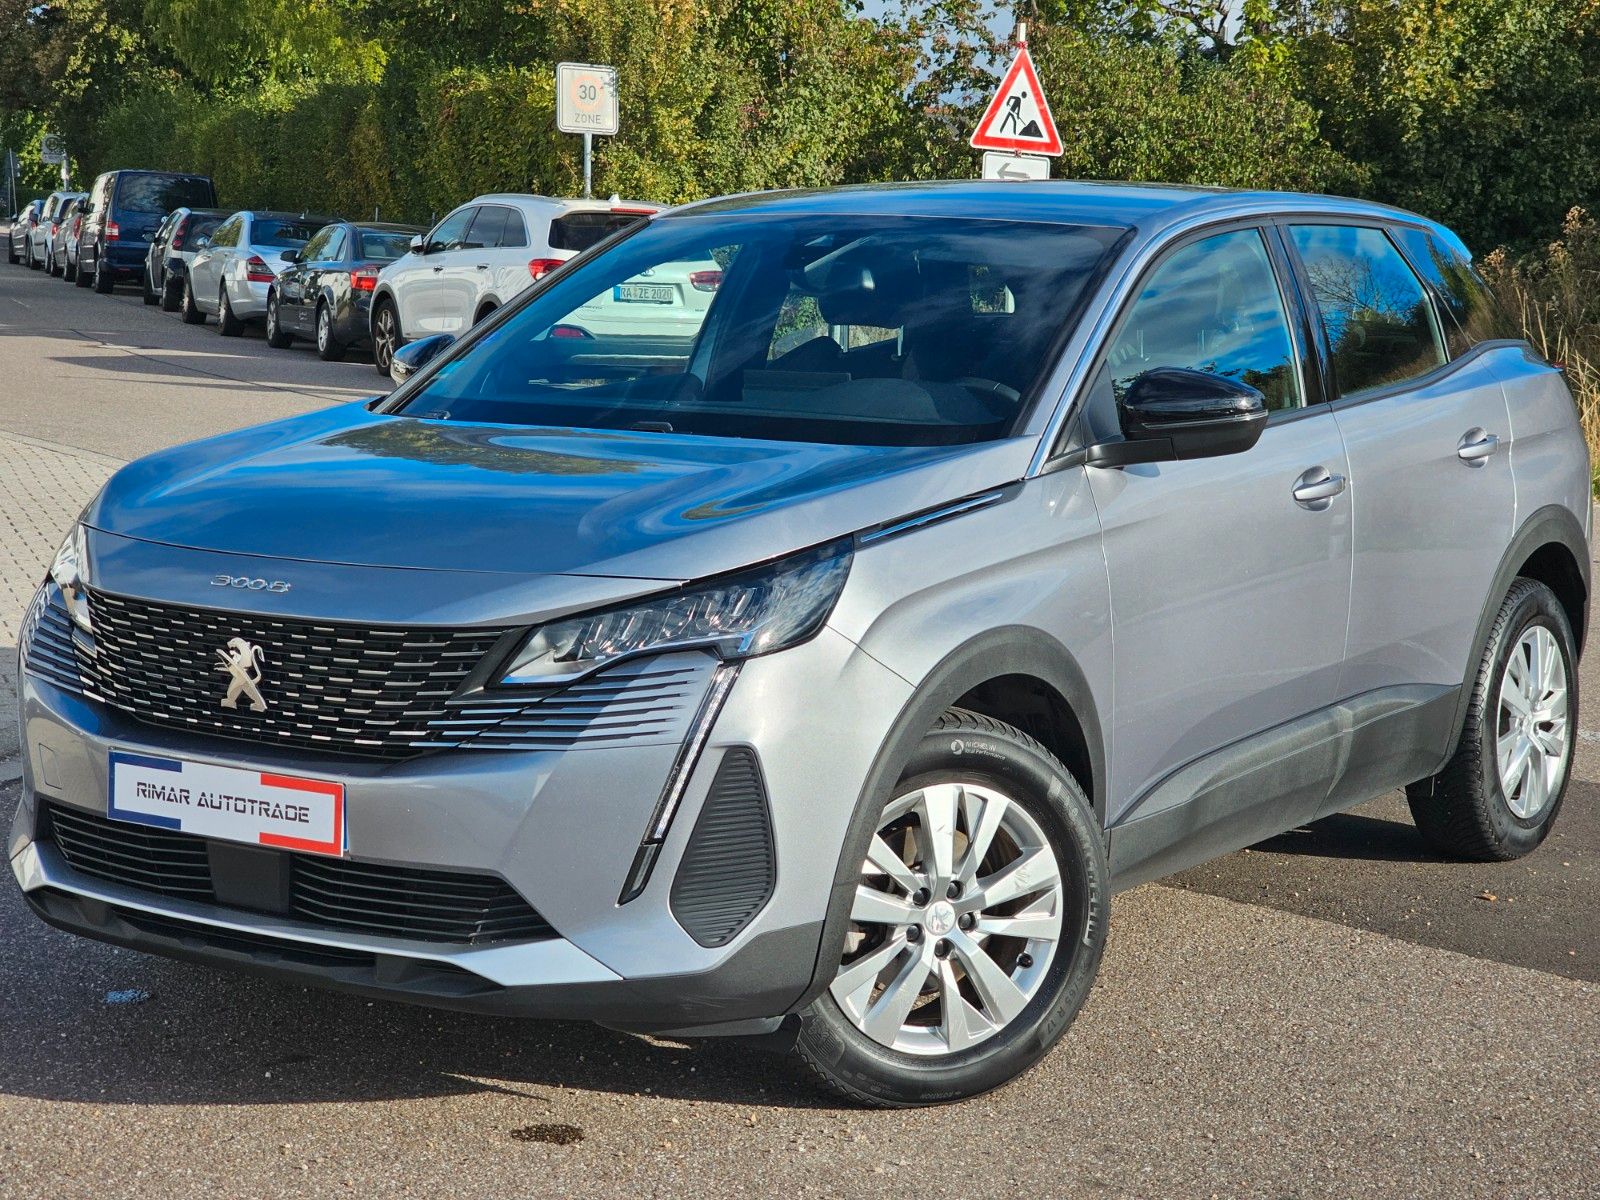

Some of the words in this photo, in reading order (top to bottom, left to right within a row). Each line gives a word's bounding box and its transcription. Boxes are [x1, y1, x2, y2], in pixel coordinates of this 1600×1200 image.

[579, 84, 597, 100] 30
[574, 113, 602, 124] ZONE
[621, 287, 632, 298] RA
[638, 288, 650, 299] ZE
[651, 288, 672, 300] 2020
[210, 575, 291, 593] 3008
[136, 781, 190, 805] RIMAR
[197, 791, 310, 824] AUTOTRADE
